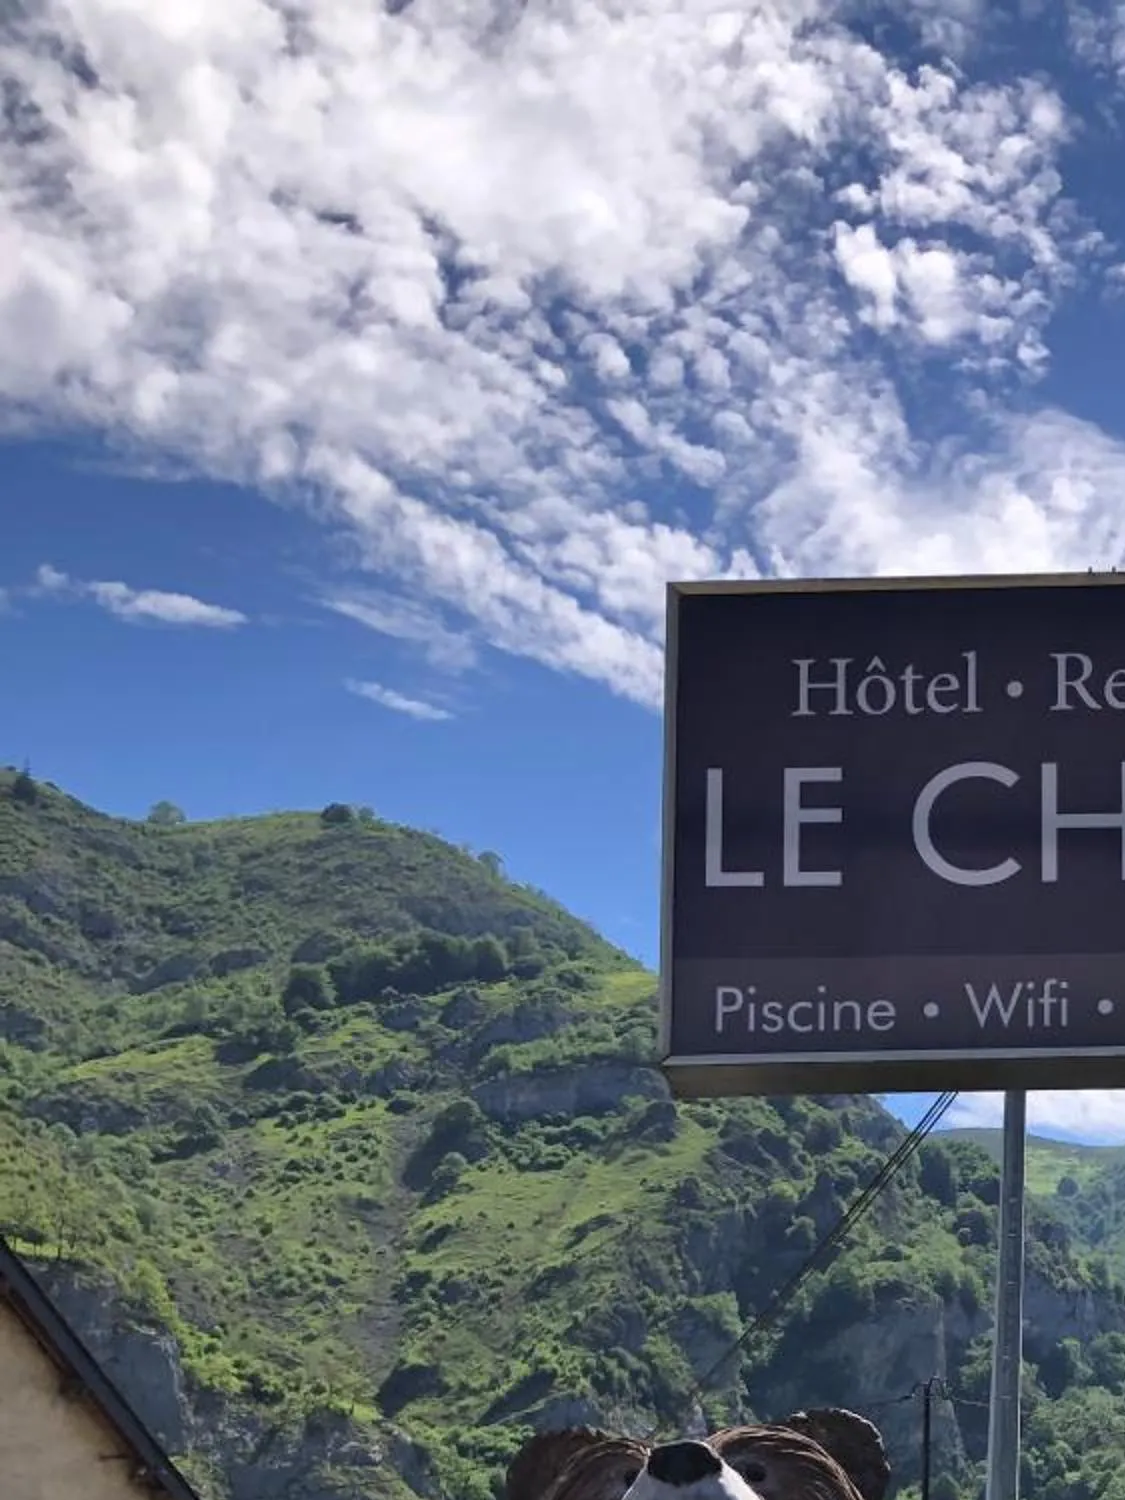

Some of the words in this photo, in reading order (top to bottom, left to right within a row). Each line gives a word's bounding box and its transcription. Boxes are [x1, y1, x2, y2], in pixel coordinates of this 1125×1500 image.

[792, 651, 983, 716] Hôtel
[705, 767, 843, 887] LE
[715, 985, 897, 1034] Piscine
[964, 978, 1070, 1029] Wifi
